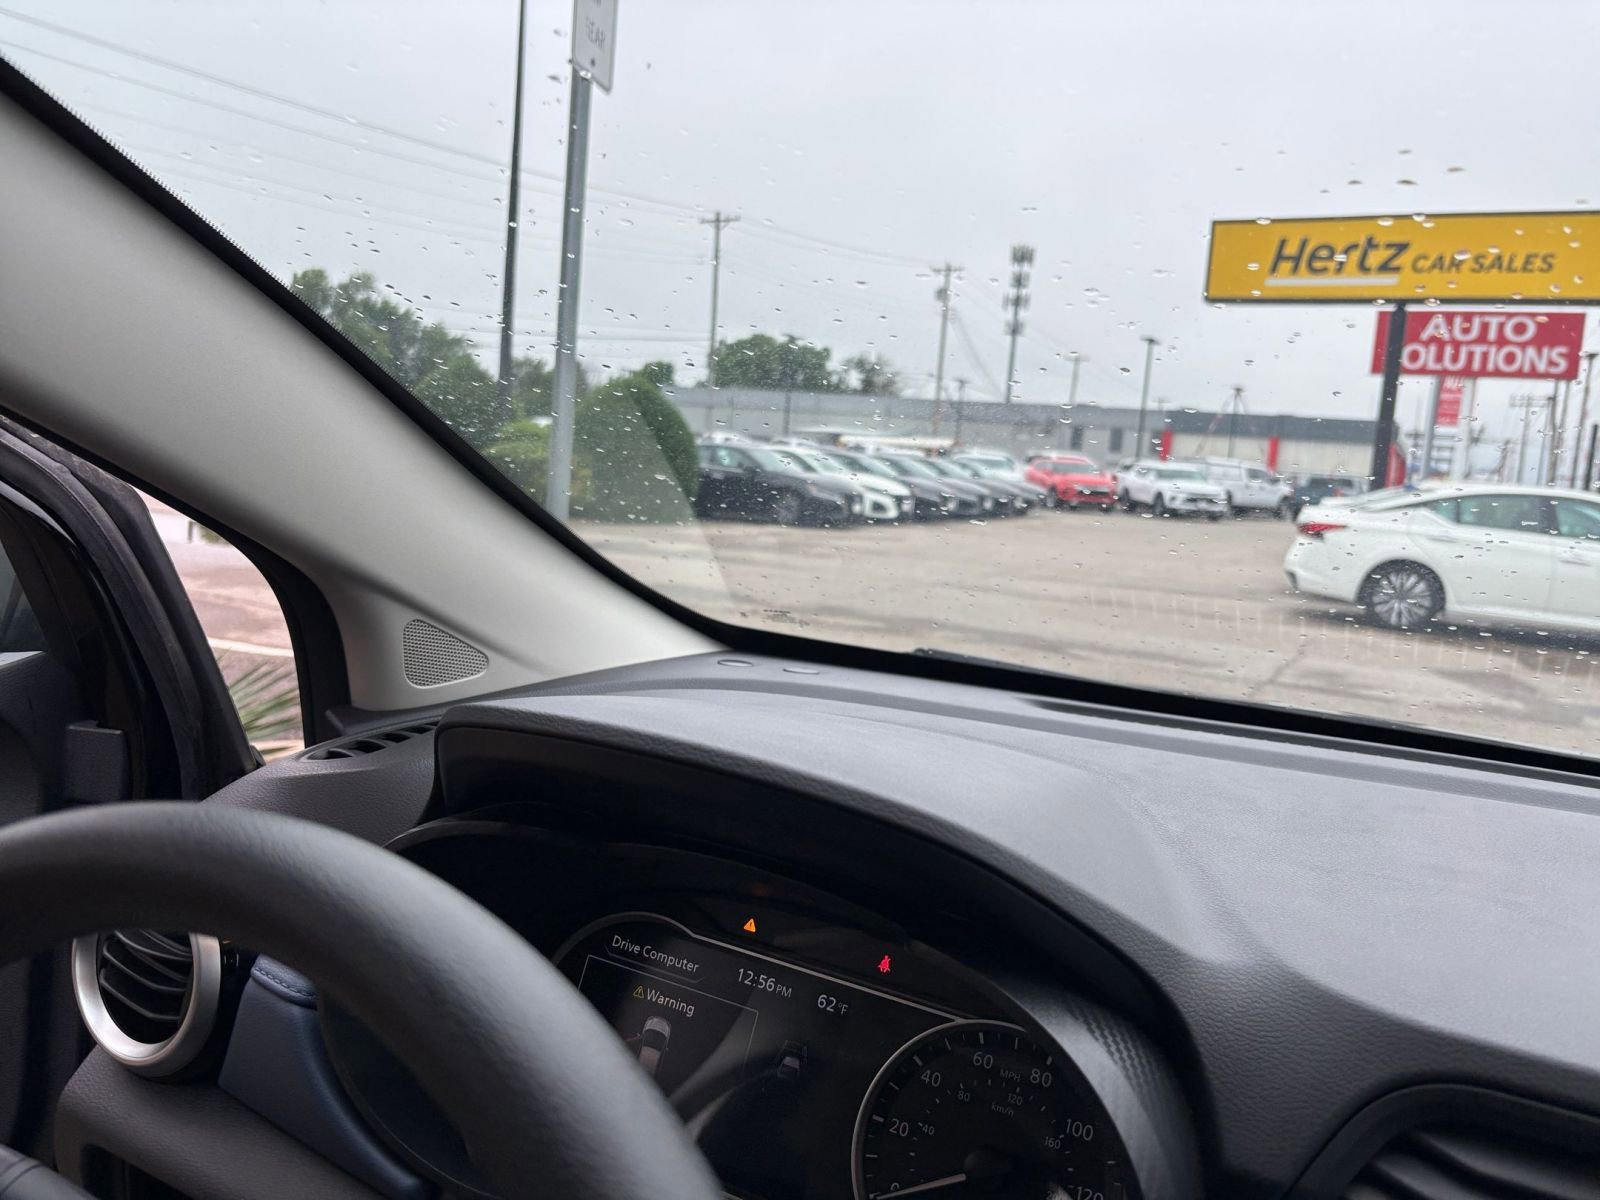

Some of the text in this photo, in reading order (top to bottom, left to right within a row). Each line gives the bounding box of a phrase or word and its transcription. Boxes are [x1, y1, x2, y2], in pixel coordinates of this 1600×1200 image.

[1269, 235, 1556, 275] Hertz CAR SALES
[1419, 315, 1537, 342] AUTO
[1402, 344, 1568, 374] OLUTIONS
[611, 935, 700, 973] Drive Computer
[646, 987, 696, 1017] Warning
[972, 1053, 993, 1069] 60
[920, 1068, 941, 1087] 40
[1000, 1068, 1021, 1082] MPH
[1030, 1068, 1052, 1087] 80
[957, 1090, 970, 1102] 80
[1008, 1093, 1023, 1106] 120
[889, 1118, 909, 1137] 20
[922, 1124, 935, 1136] 40
[1066, 1119, 1094, 1141] 100
[1045, 1136, 1061, 1150] 160
